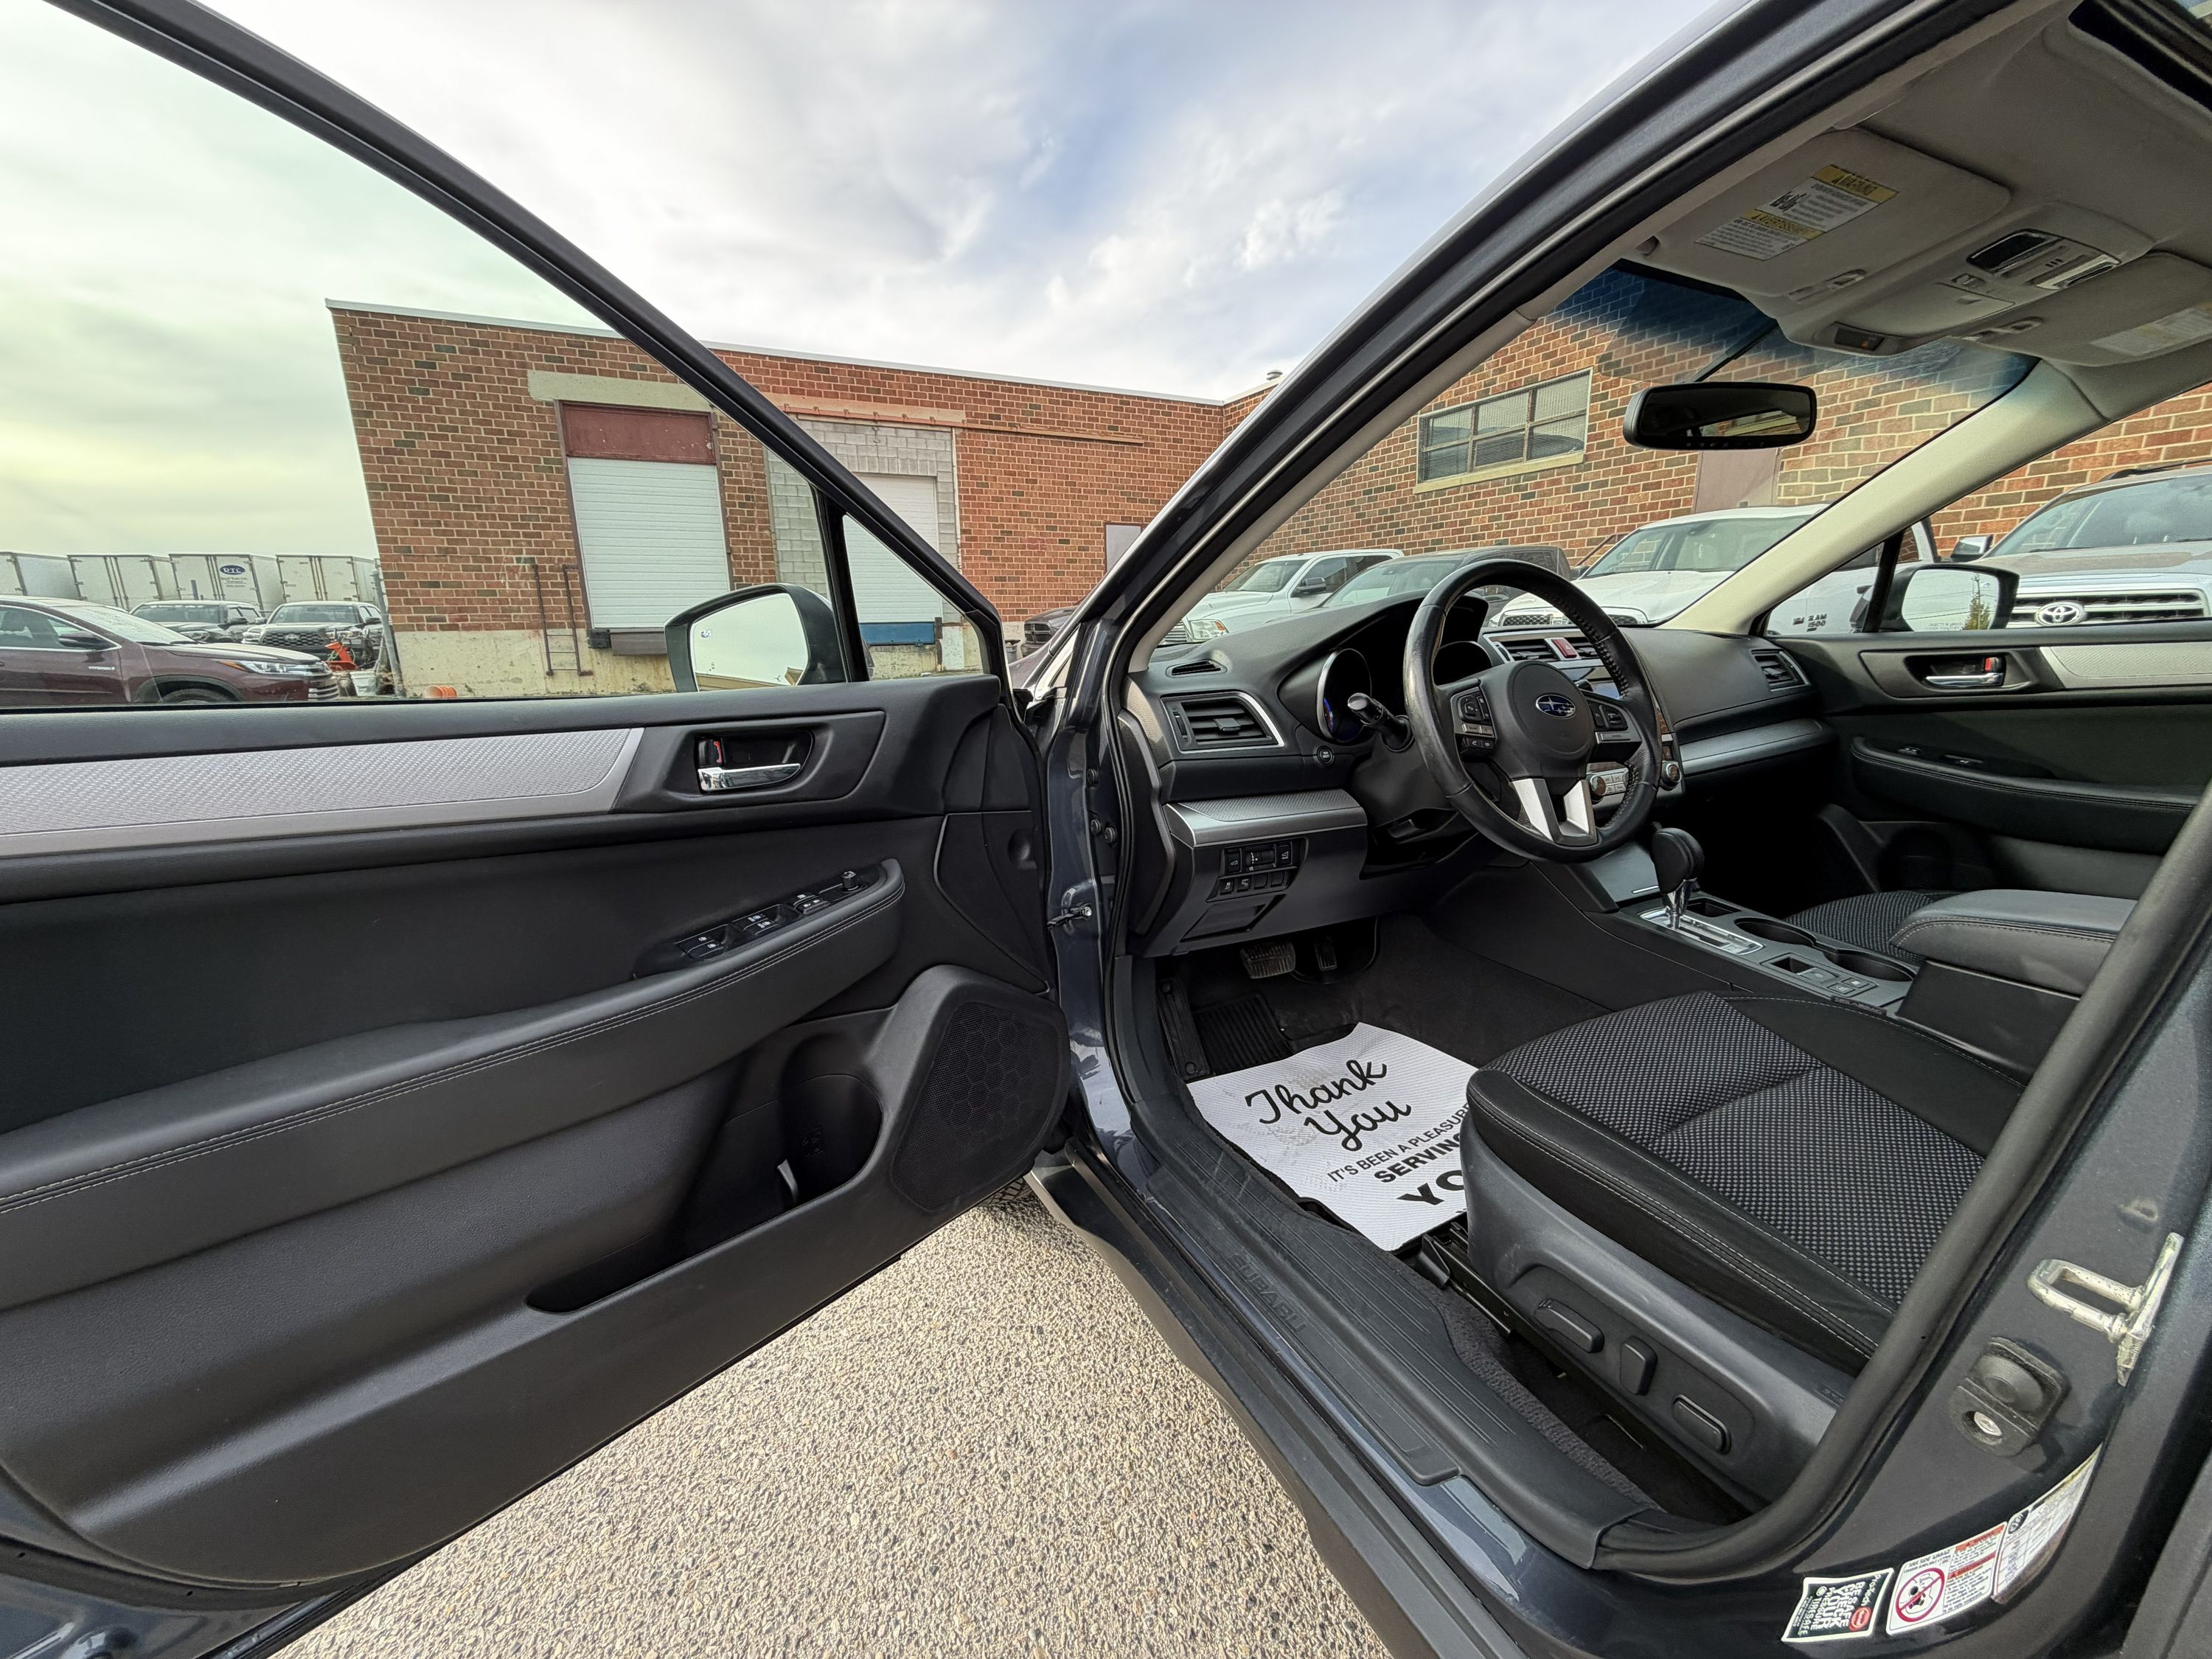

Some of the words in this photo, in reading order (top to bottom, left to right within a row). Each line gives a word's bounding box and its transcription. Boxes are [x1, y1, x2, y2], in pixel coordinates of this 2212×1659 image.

[1808, 613, 1827, 622] RAM
[1245, 1060, 1388, 1124] Thank
[1304, 1100, 1412, 1152] You
[1327, 1165, 1359, 1183] IT'S
[1356, 1149, 1399, 1170] BEEN
[1397, 1144, 1411, 1153] A
[1396, 1169, 1465, 1206] YO
[1817, 1585, 1845, 1630] YOUR
[1829, 1583, 1855, 1628] CHECK
[1850, 1581, 1865, 1597] BE
[1840, 1596, 1858, 1627] SAFE
